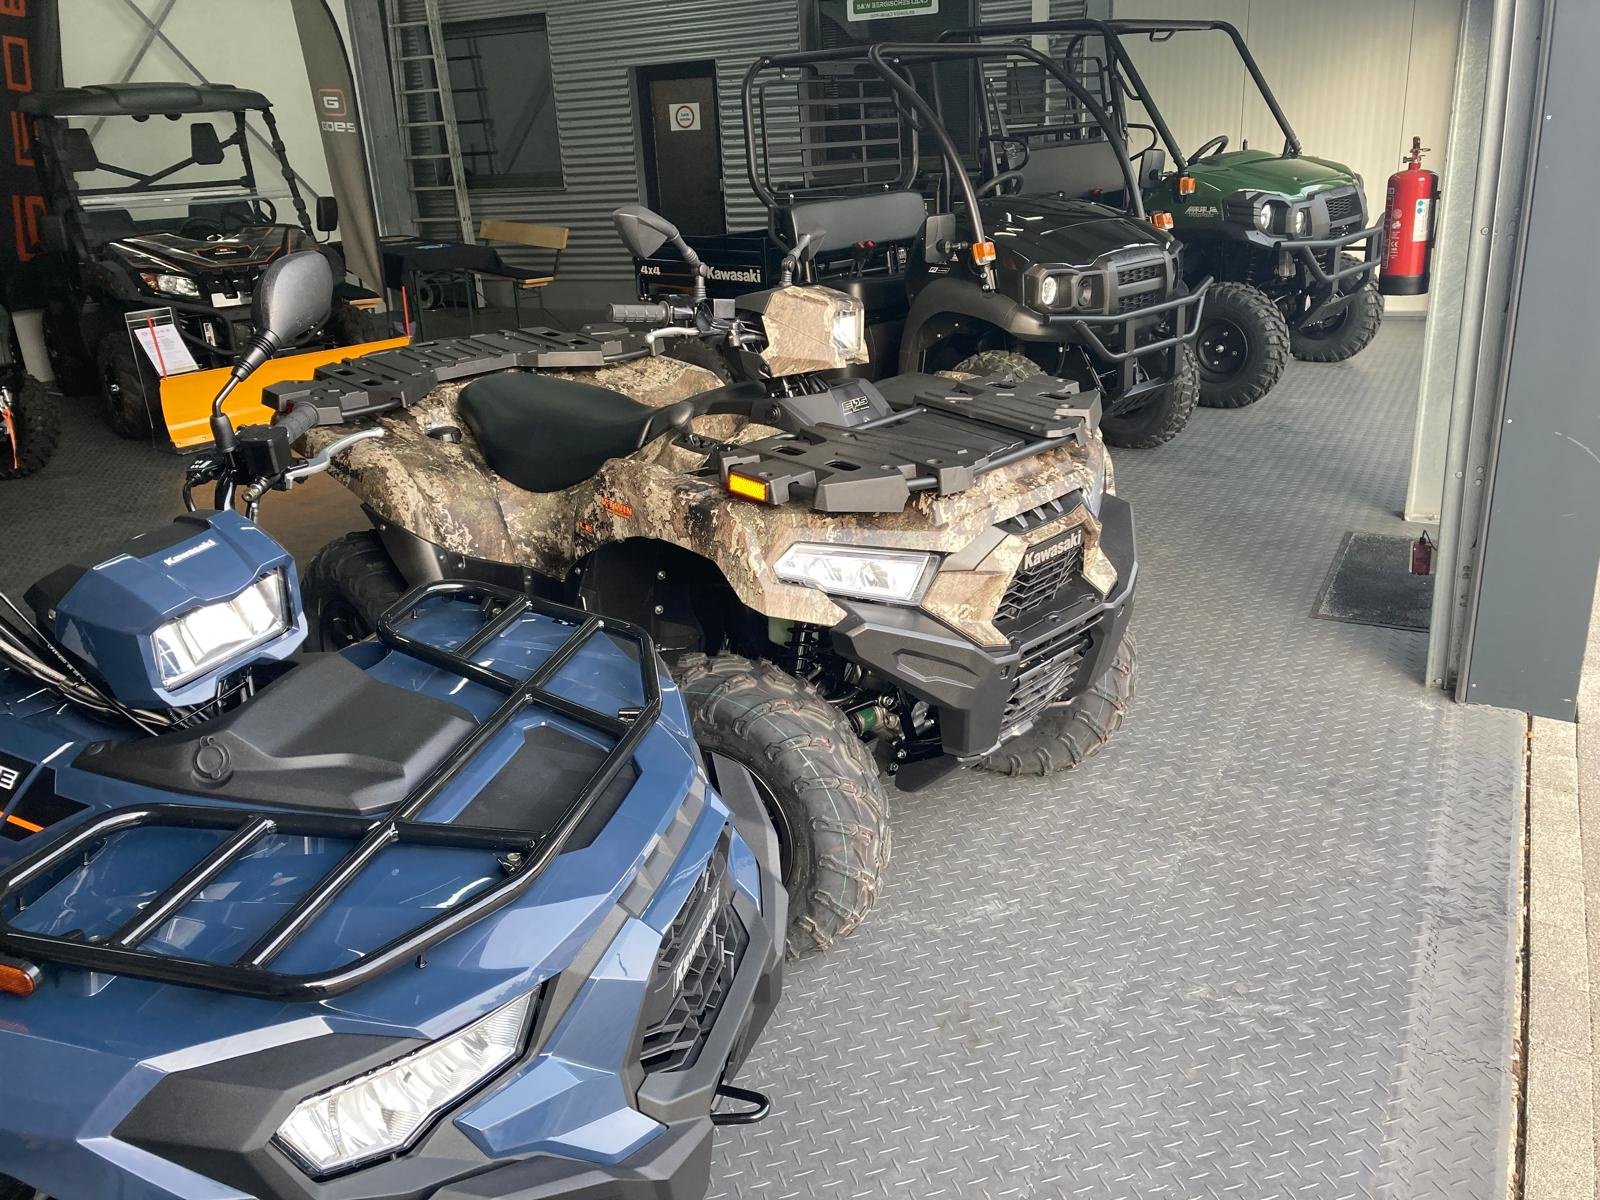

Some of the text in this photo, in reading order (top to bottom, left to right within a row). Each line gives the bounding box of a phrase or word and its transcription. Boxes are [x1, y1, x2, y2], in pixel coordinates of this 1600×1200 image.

[640, 265, 661, 275] 4x4
[706, 266, 761, 283] Kawasaki
[1023, 529, 1082, 571] Kawasaki
